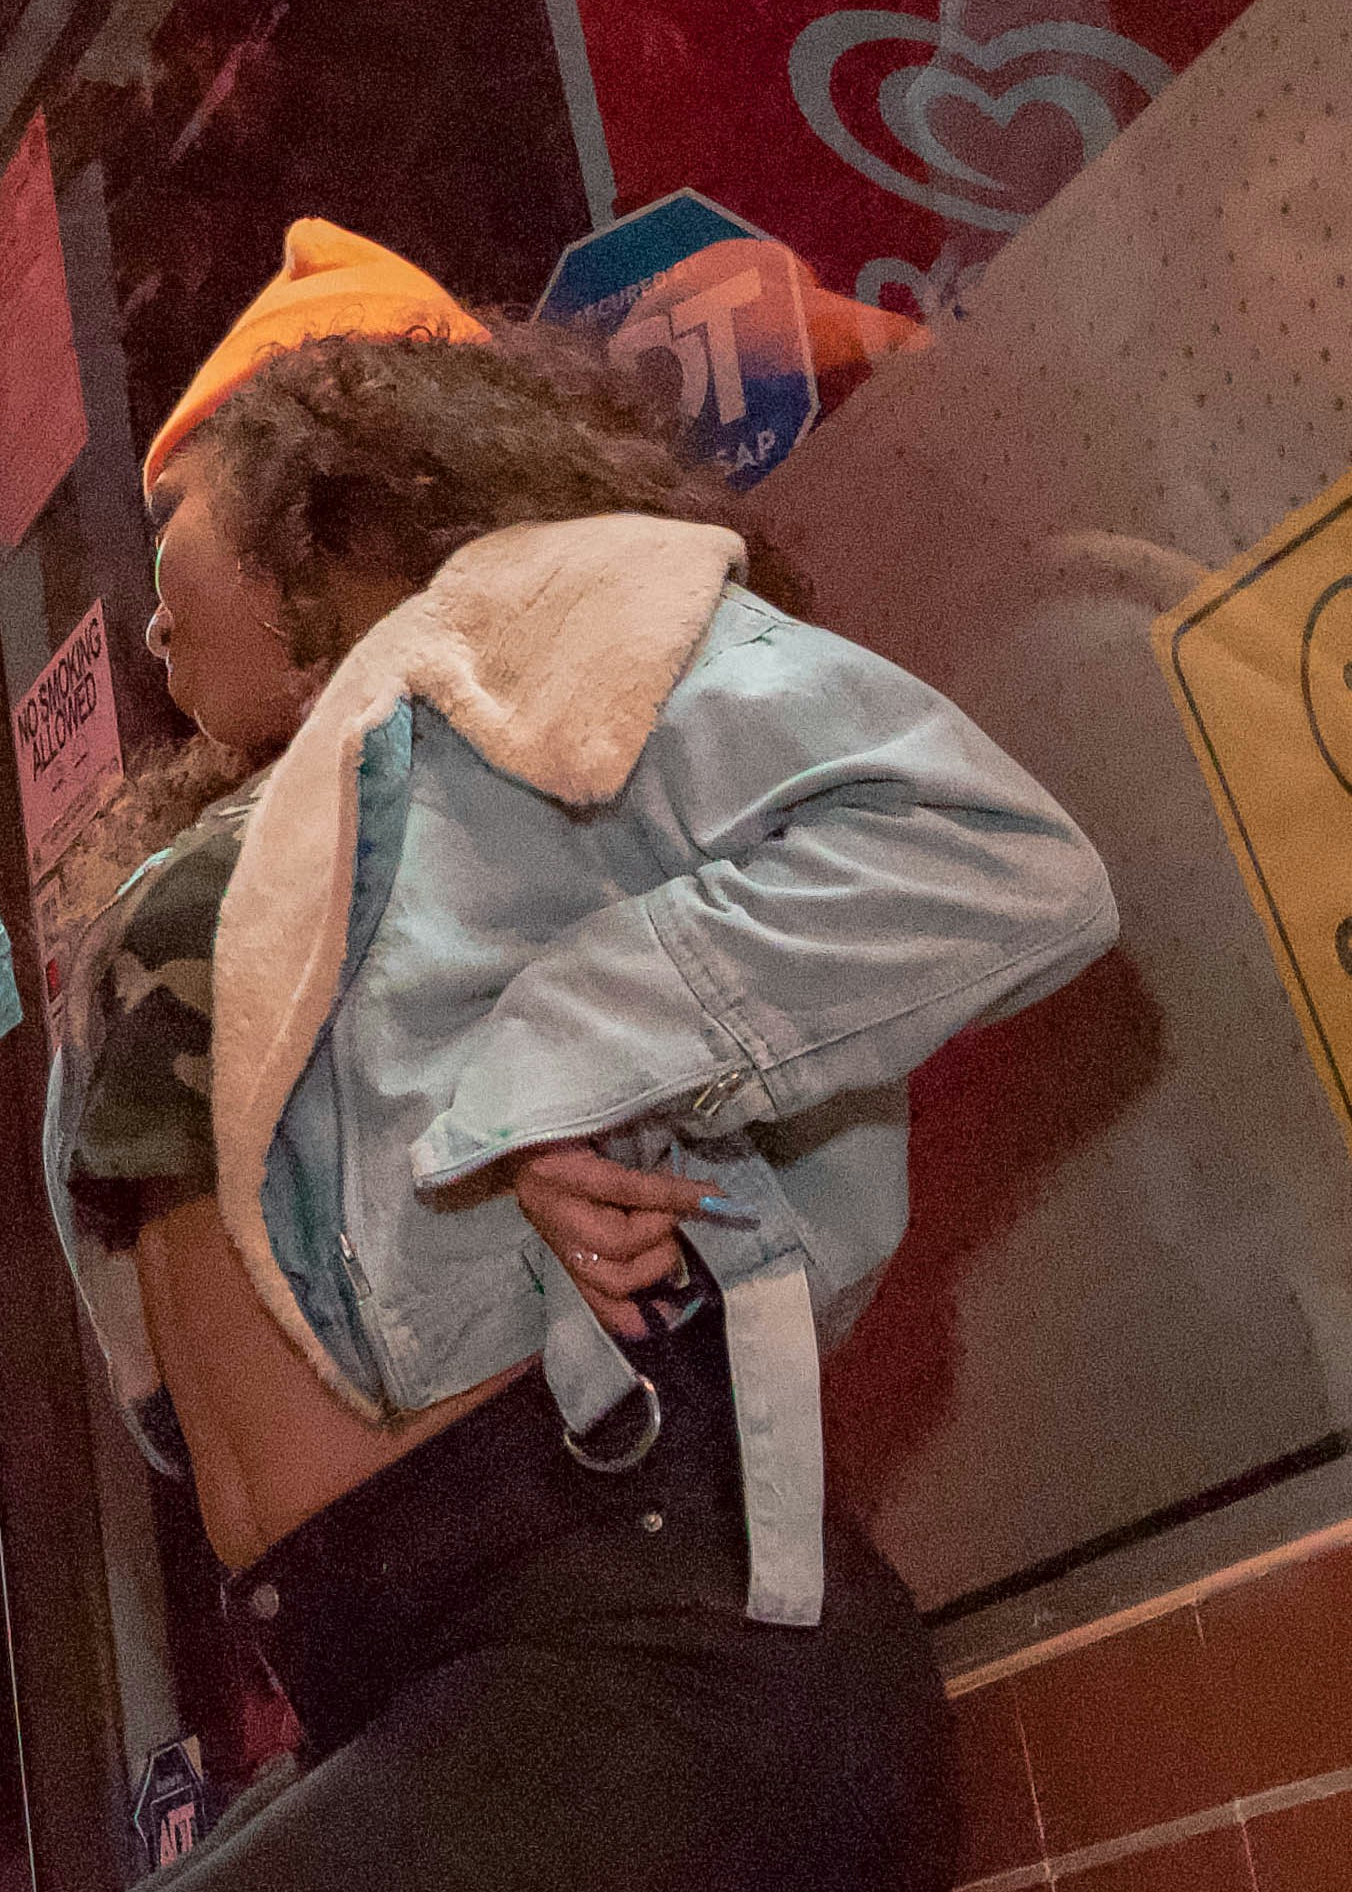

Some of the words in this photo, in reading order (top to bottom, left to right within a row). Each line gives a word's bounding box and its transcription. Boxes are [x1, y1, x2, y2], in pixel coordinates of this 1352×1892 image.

[17, 698, 39, 748] NO
[38, 617, 101, 725] SMOKING
[33, 671, 97, 783] ALLOWED
